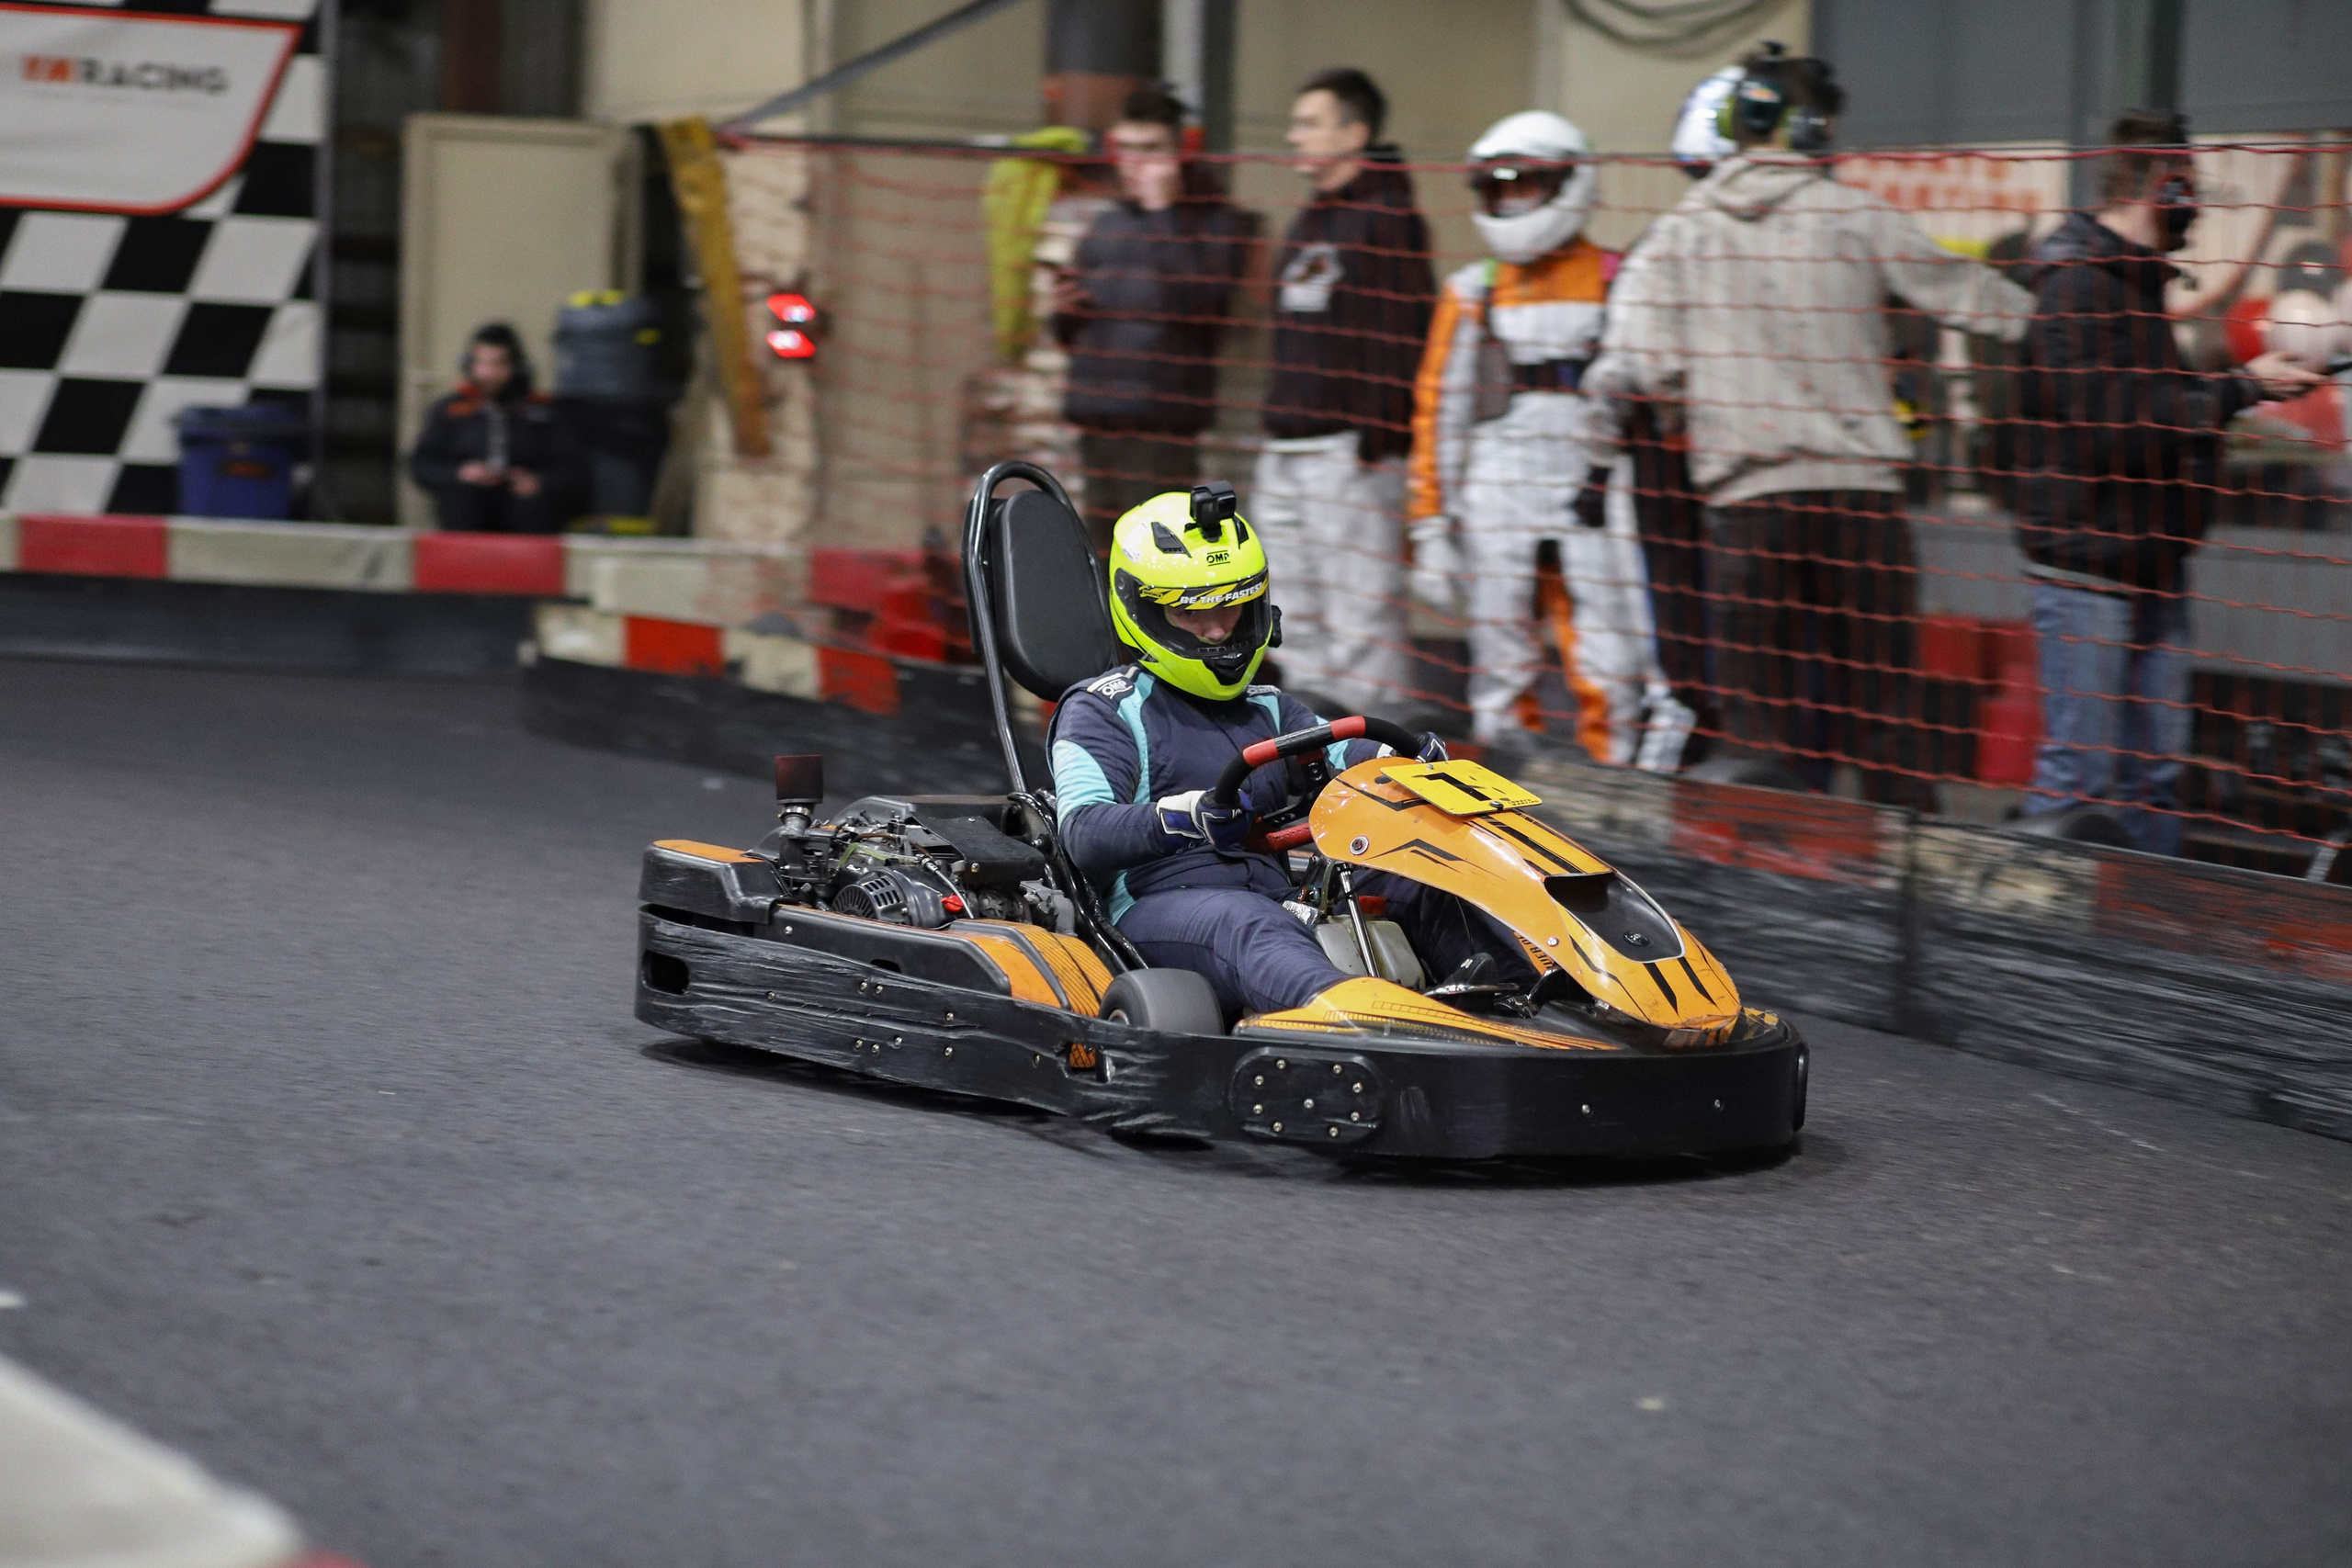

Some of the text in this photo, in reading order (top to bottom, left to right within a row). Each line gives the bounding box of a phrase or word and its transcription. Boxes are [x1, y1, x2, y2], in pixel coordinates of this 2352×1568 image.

[1206, 552, 1229, 563] OMP
[1180, 581, 1263, 604] BE THE FASTEST
[1102, 680, 1127, 696] OMP
